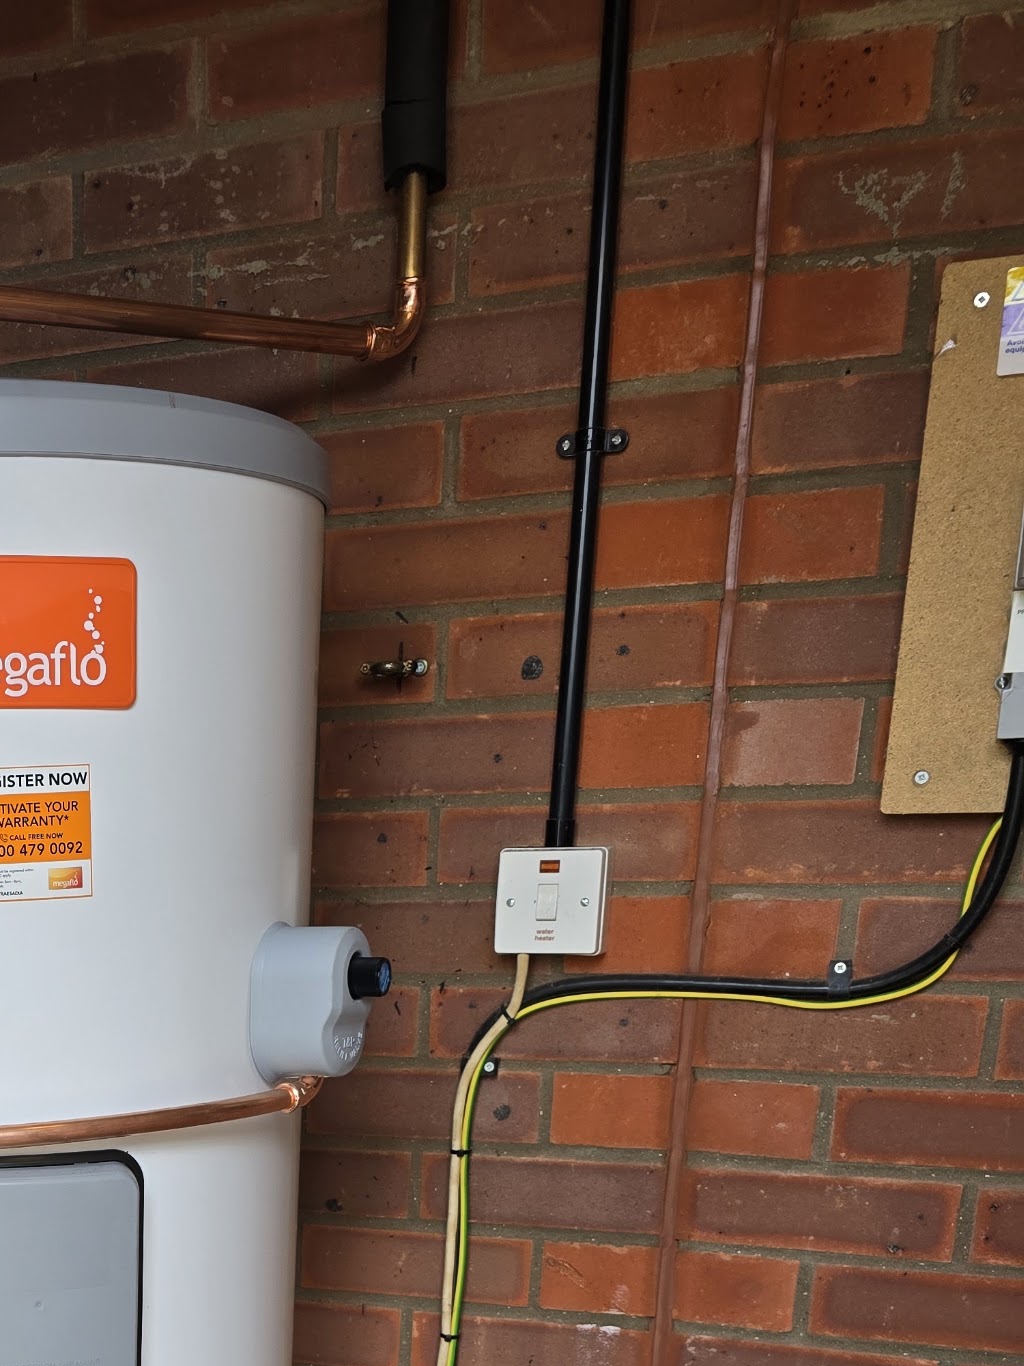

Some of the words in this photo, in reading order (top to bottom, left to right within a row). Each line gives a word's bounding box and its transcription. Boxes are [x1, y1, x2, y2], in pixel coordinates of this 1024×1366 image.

[49, 772, 88, 786] NOW
[45, 801, 78, 812] YOUR
[20, 843, 45, 856] 479
[50, 841, 82, 854] 0092
